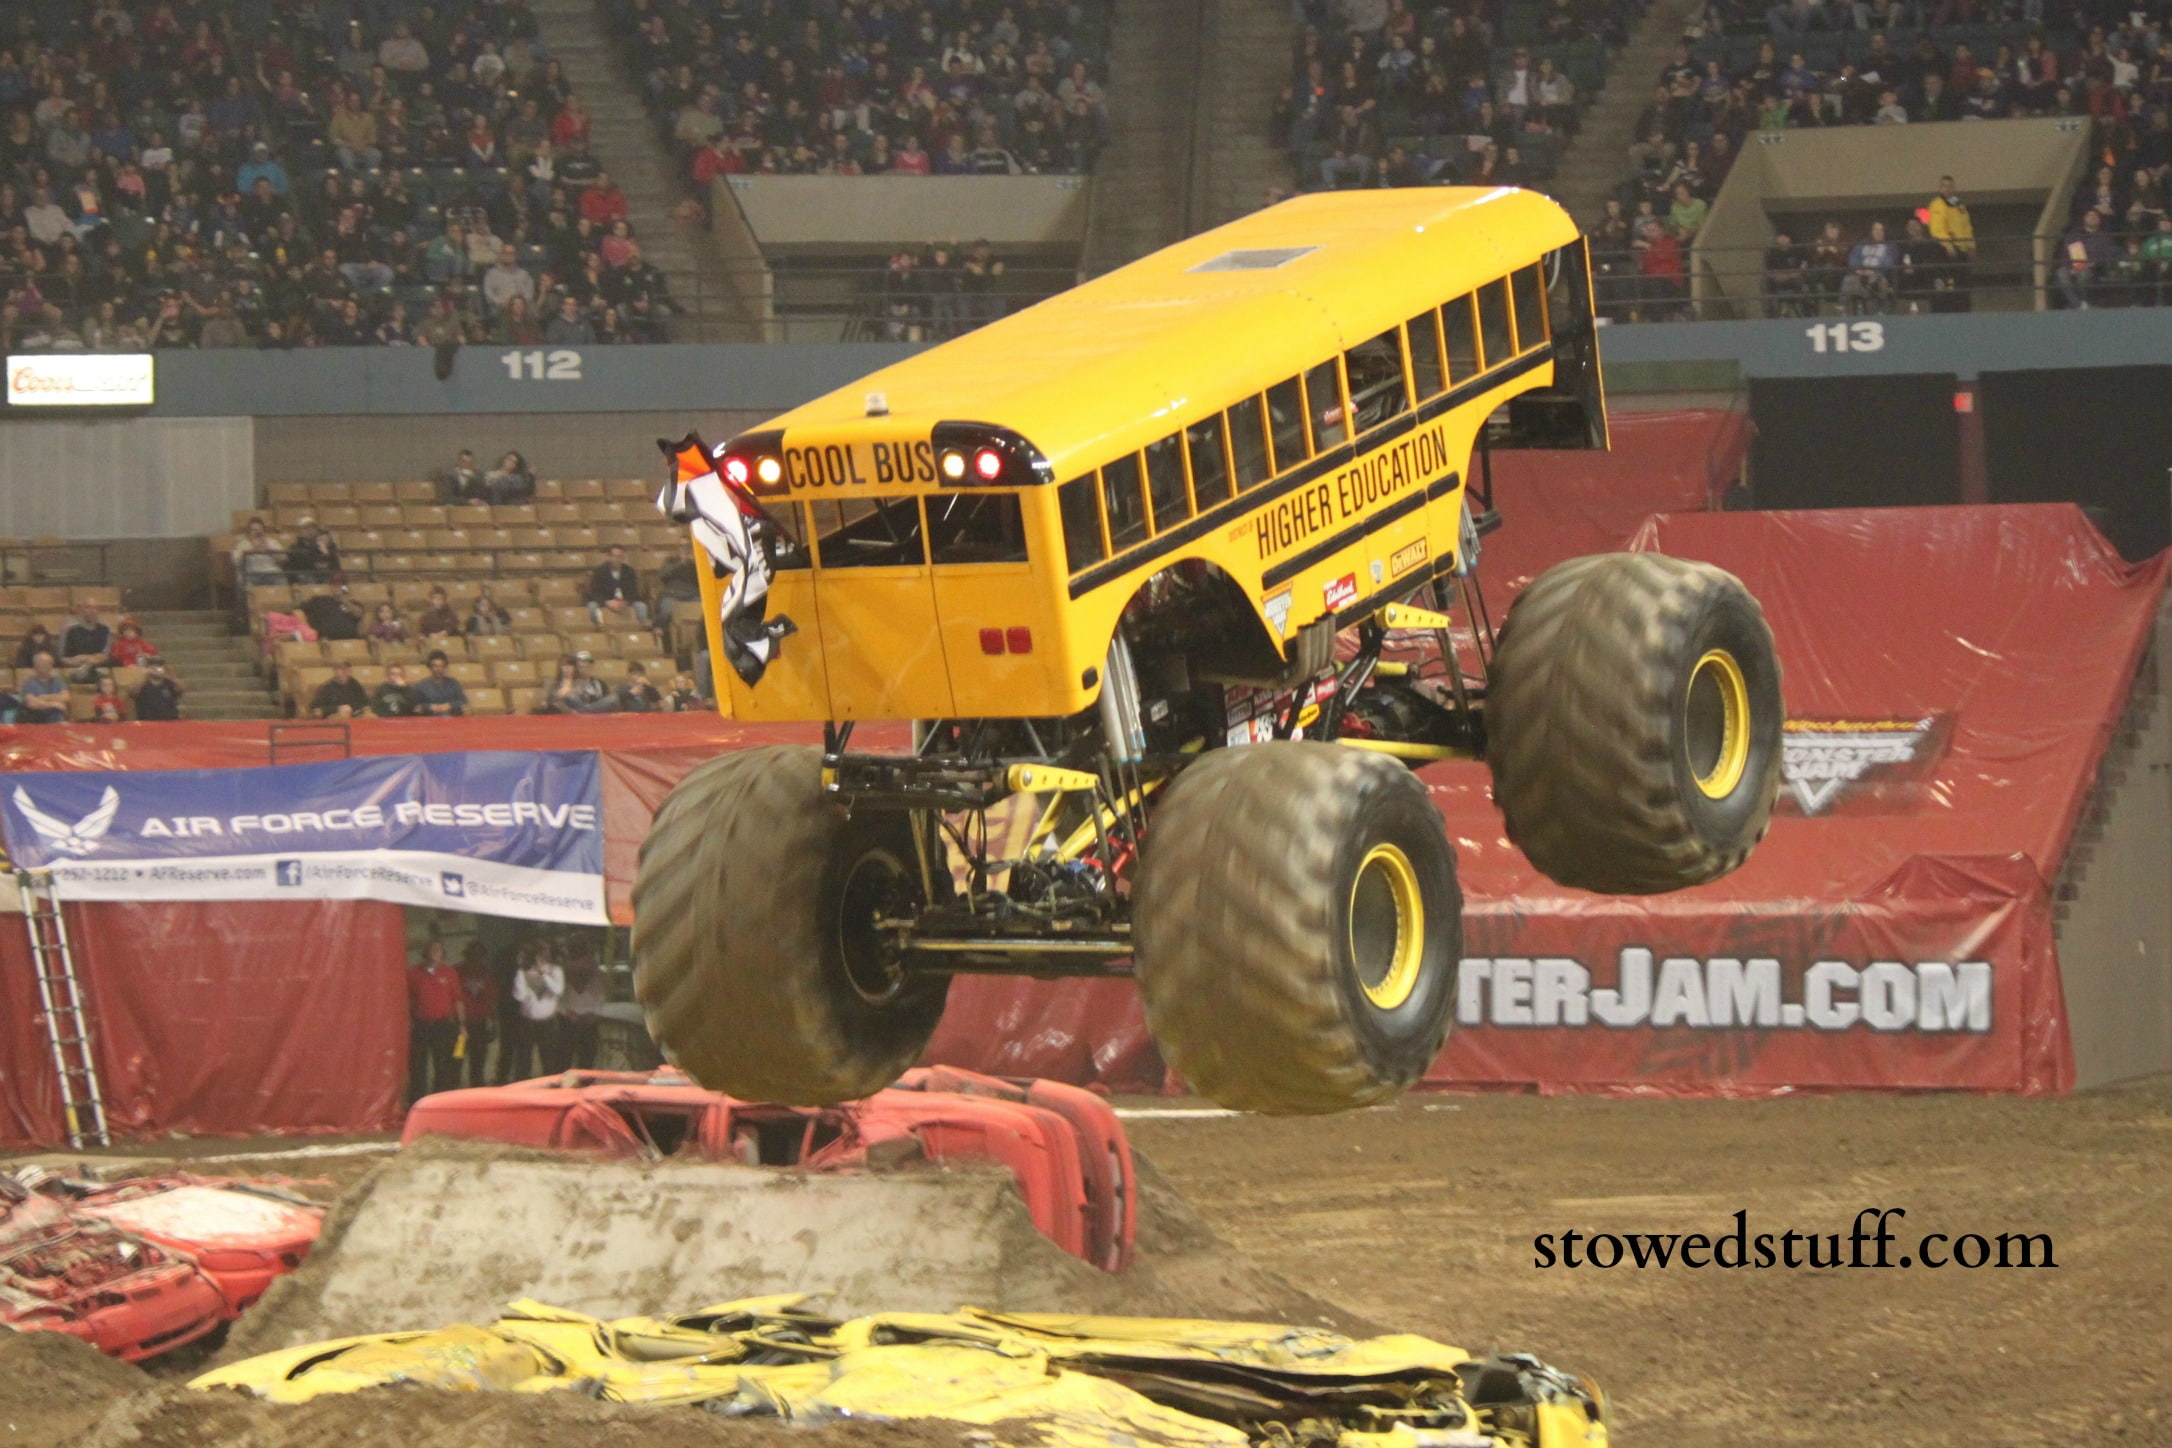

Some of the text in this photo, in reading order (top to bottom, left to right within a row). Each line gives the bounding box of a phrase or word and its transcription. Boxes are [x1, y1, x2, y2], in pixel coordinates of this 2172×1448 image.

[1806, 321, 1884, 353] 113
[501, 350, 582, 380] 112
[785, 440, 936, 488] COOL BUS
[1256, 483, 1333, 560] HIGHER
[1337, 425, 1448, 519] EDUCATION
[140, 800, 596, 838] AIR FORCE RESERVE
